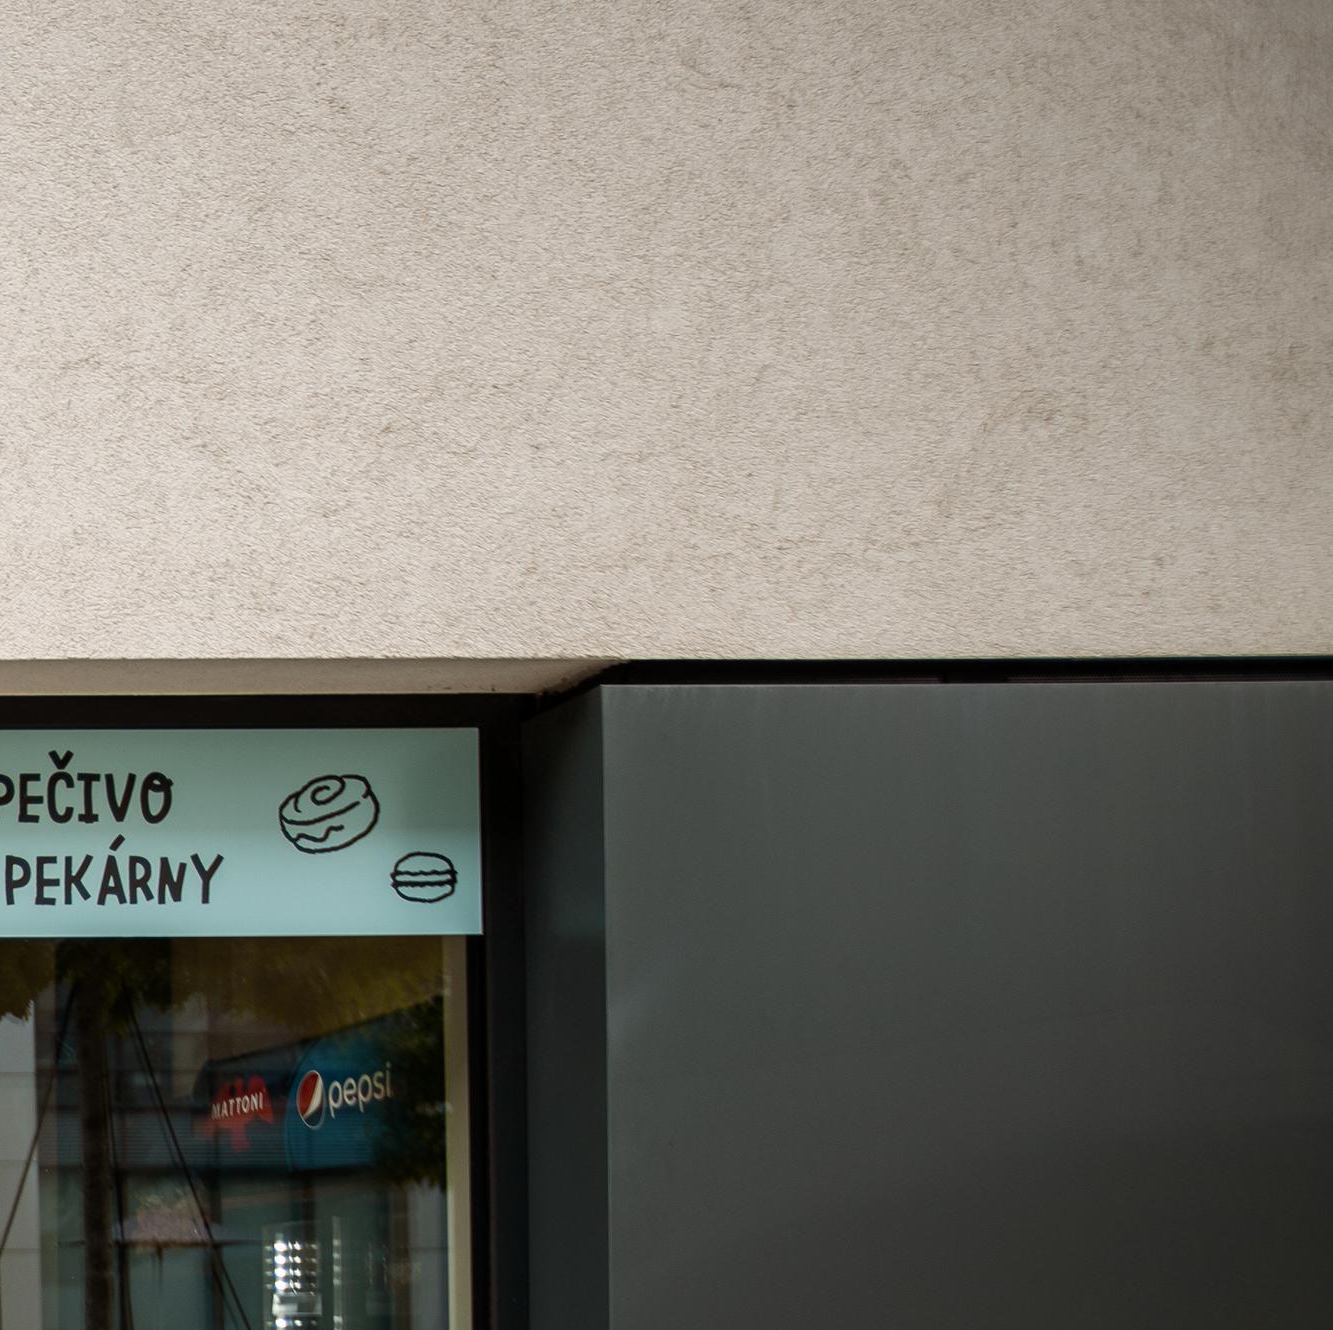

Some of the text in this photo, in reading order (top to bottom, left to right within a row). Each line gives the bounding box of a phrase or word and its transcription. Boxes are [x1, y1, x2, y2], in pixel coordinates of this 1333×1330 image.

[4, 833, 225, 906] PEKÁRNY
[211, 1091, 265, 1121] MATTONI
[328, 1061, 393, 1119] pepsi
